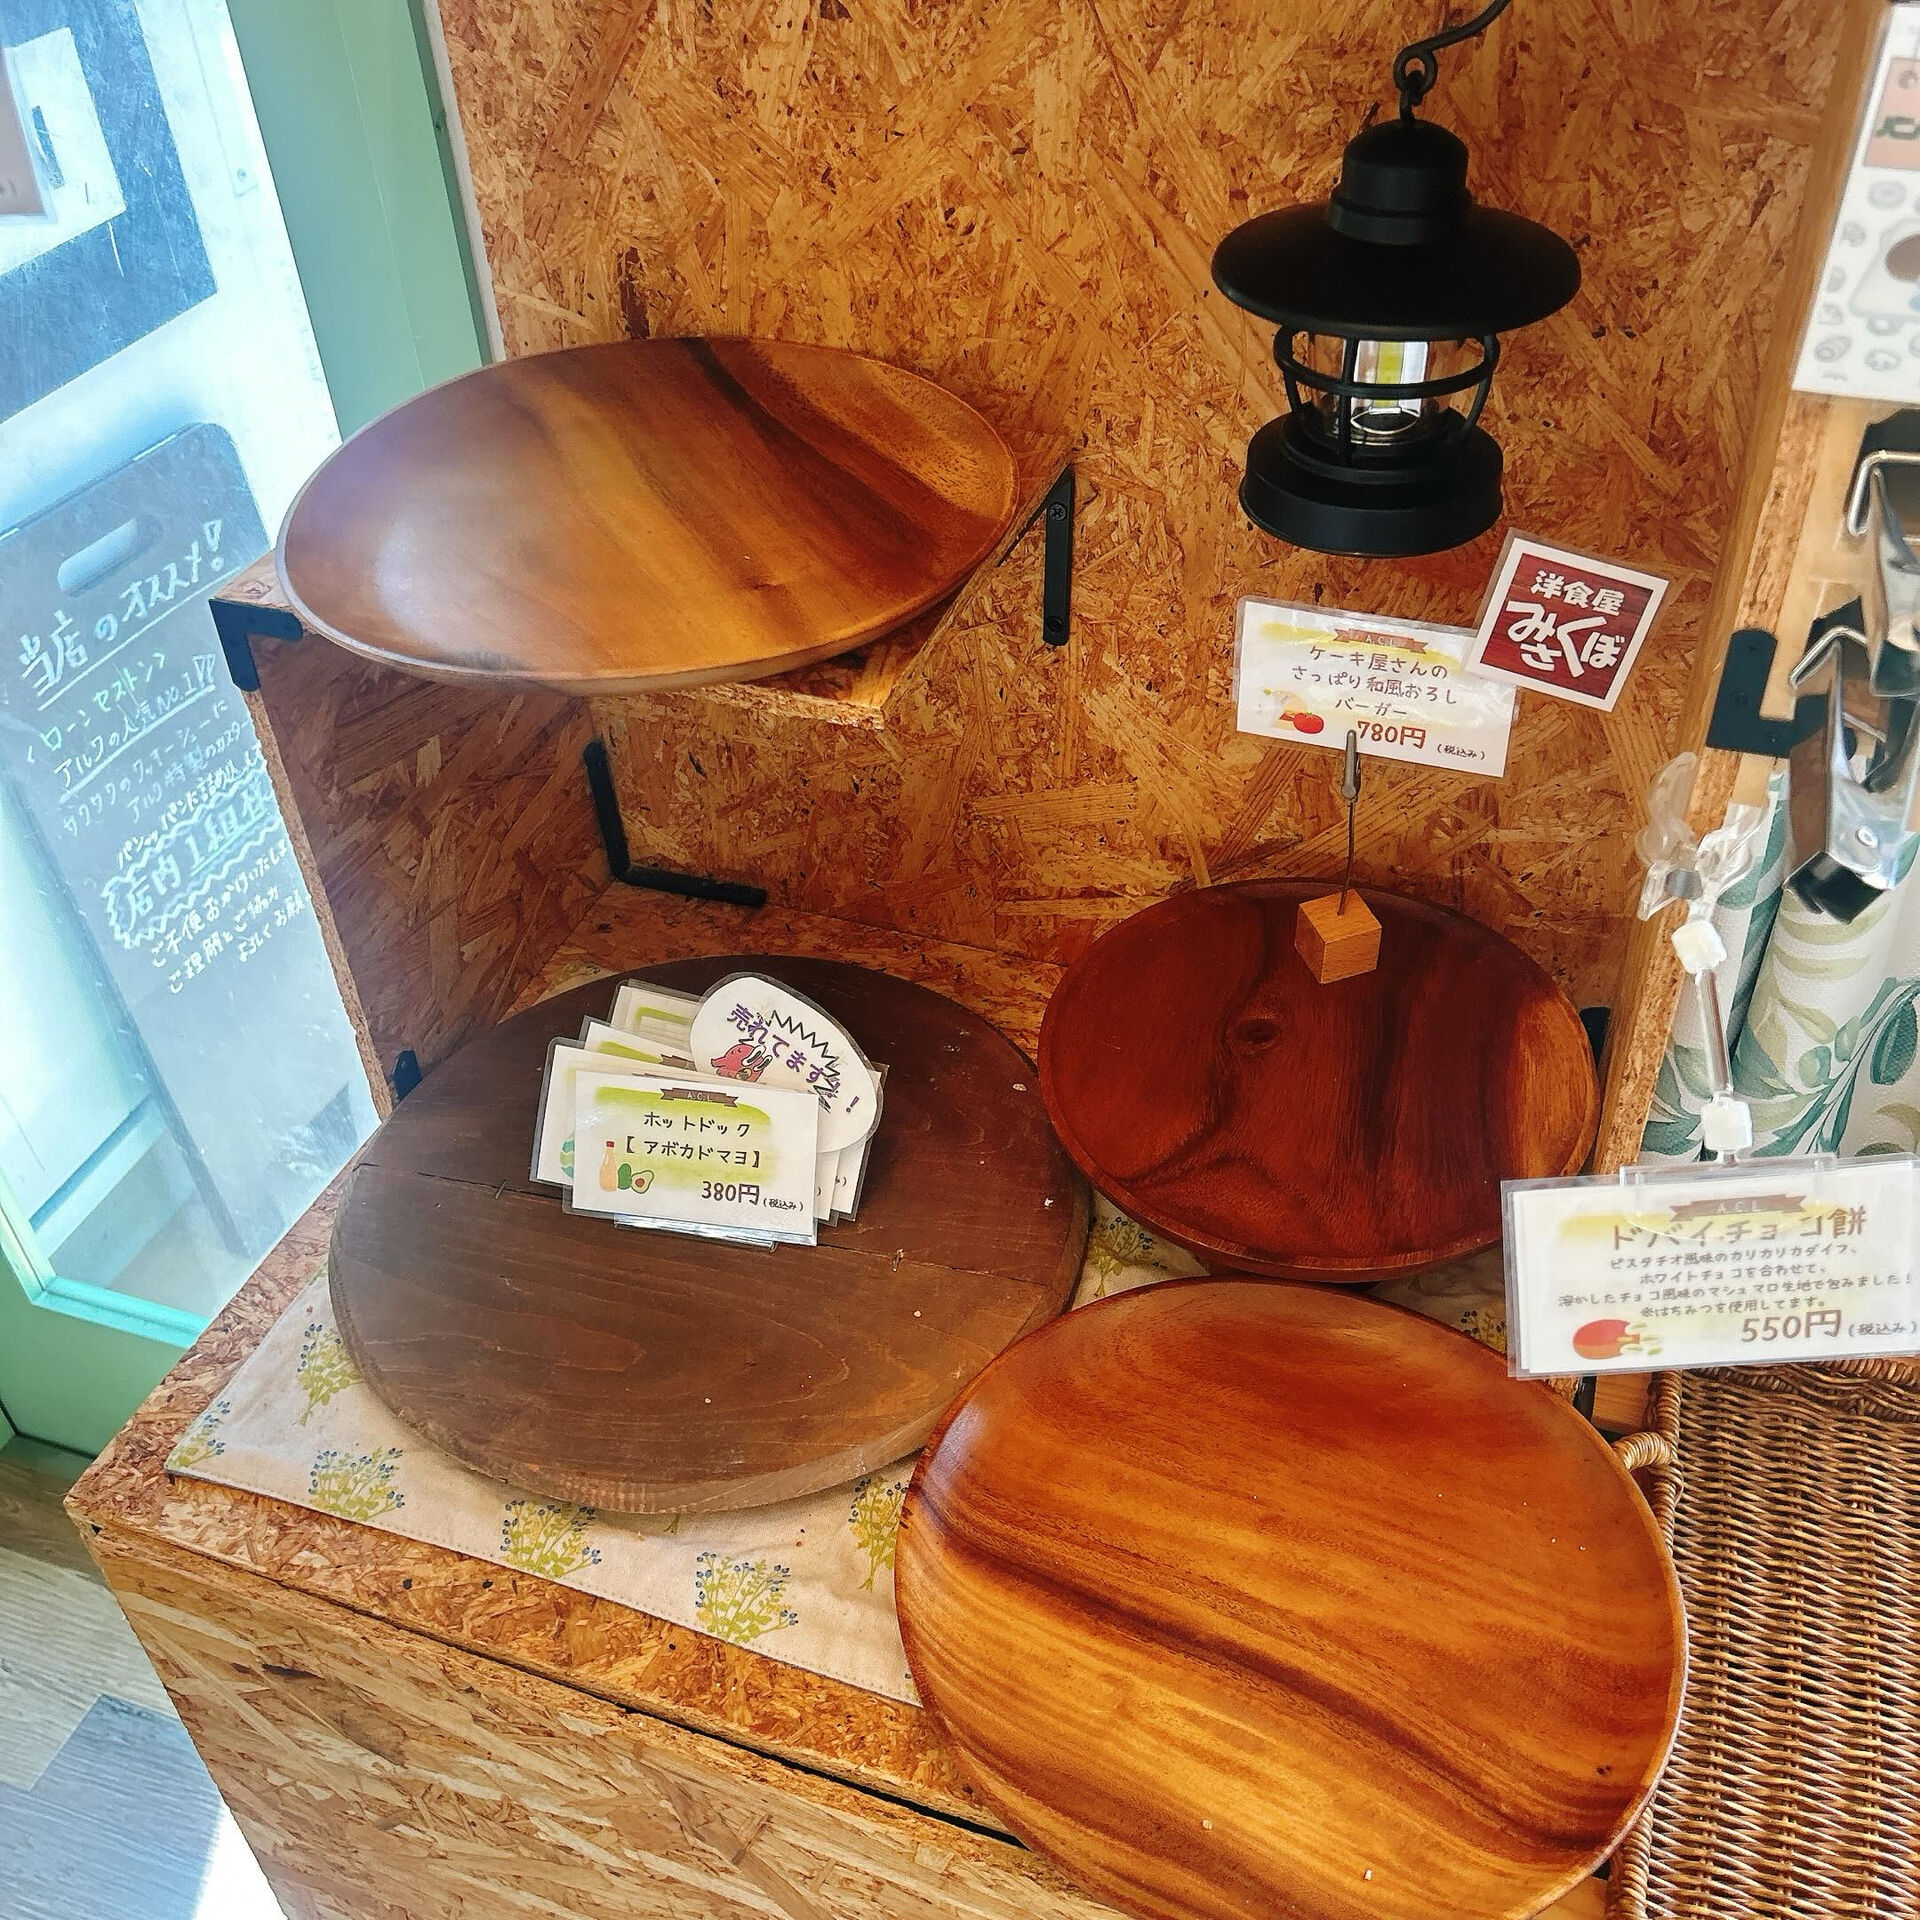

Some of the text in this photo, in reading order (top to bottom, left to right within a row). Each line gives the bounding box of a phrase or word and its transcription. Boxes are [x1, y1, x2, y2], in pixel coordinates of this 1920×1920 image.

[1530, 570, 1626, 616] 洋食屋
[1309, 645, 1448, 679] ケーキ屋さんの
[1292, 665, 1458, 705] さっぱり和風おろし
[1335, 696, 1408, 717] バーガー
[1357, 720, 1427, 749] 780円
[643, 1111, 750, 1138] ホットドック
[626, 1135, 760, 1169] 【アボカドマヨ】
[701, 1180, 760, 1206] 380円
[1613, 1205, 1867, 1250] ドバイチョコ餅
[1741, 1309, 1842, 1342] 550円
